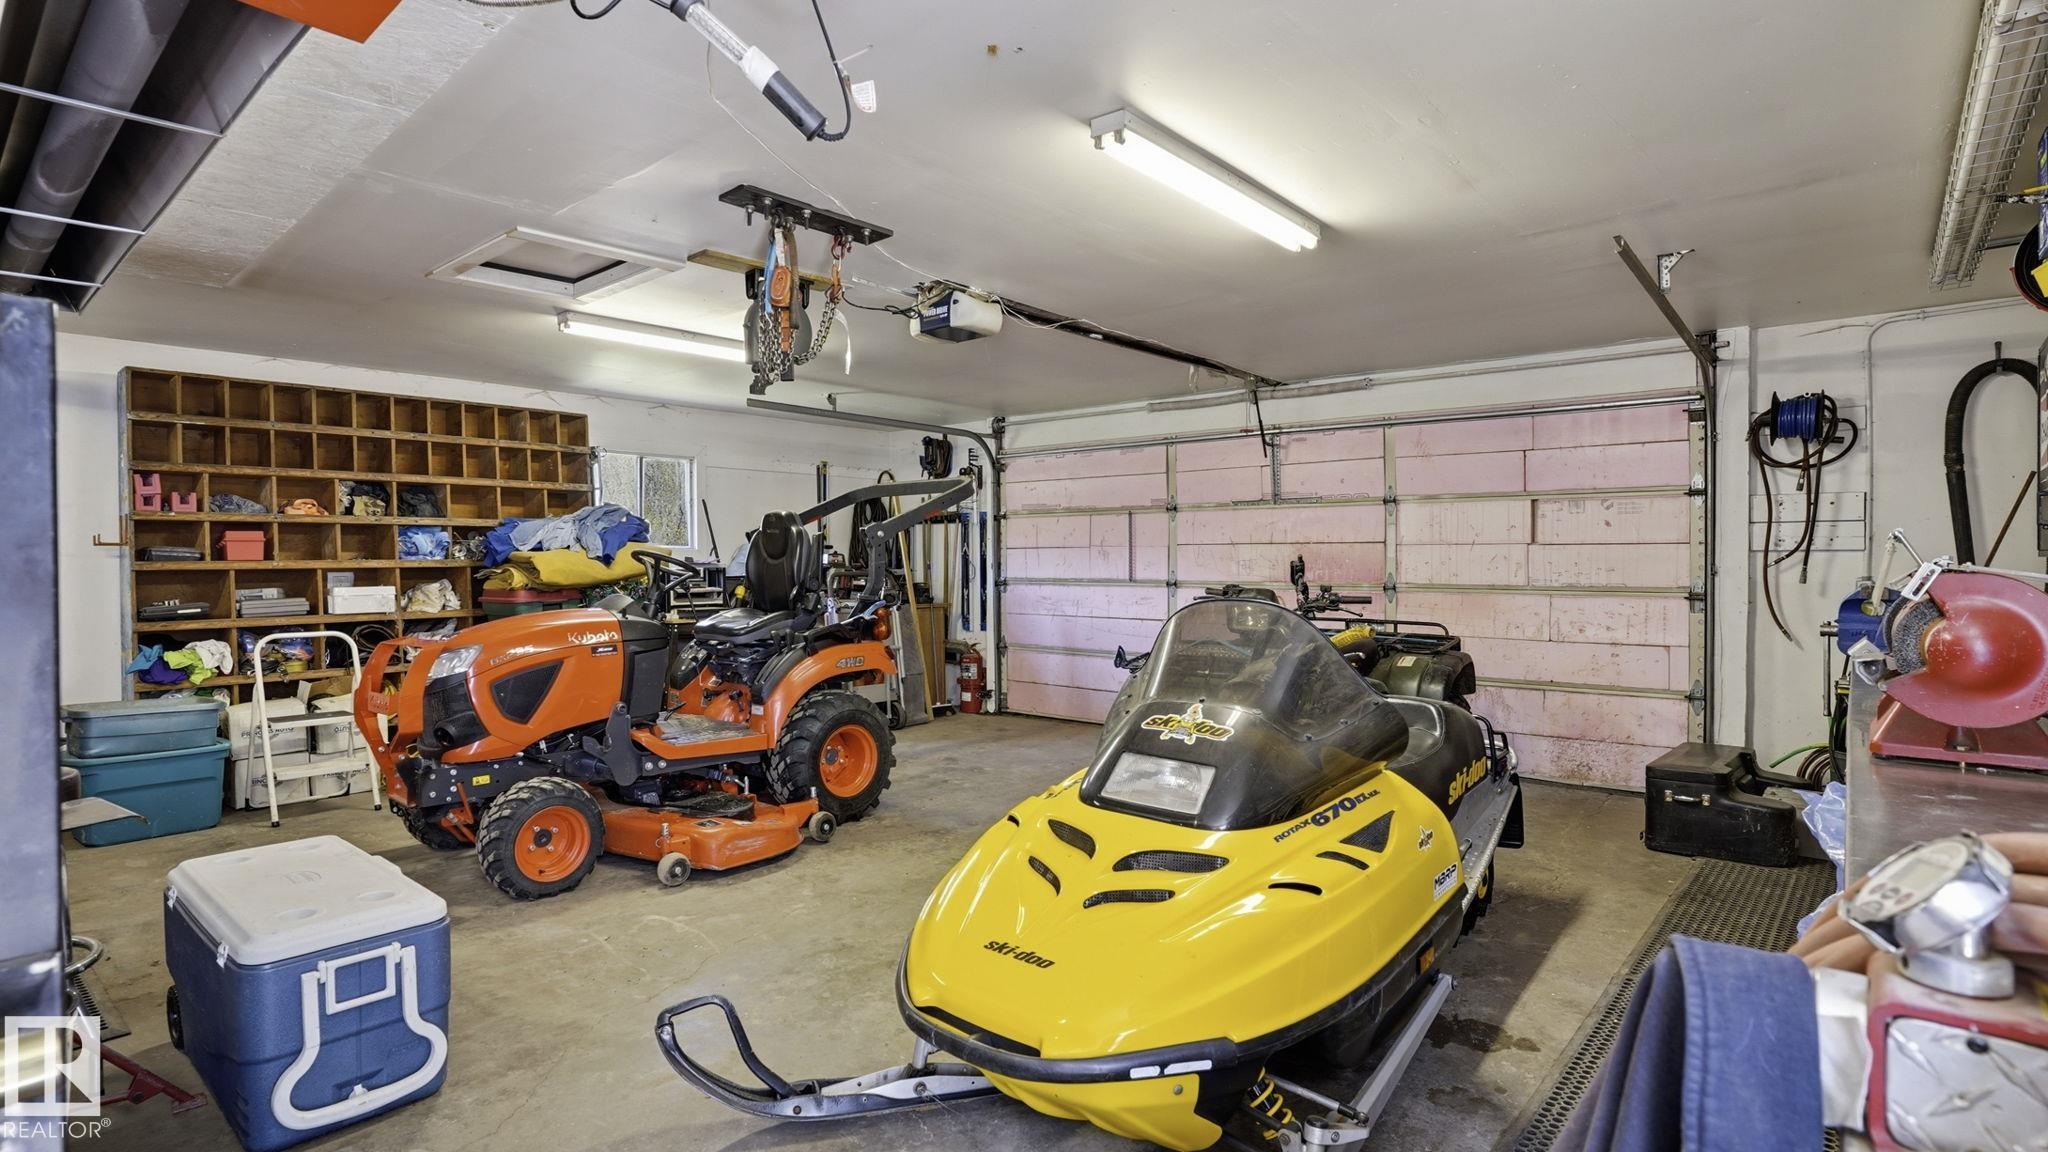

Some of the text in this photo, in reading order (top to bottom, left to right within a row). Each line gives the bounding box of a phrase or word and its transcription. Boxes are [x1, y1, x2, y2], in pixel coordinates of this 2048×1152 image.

[567, 629, 618, 645] Kubota
[836, 656, 864, 668] 4WD
[1448, 756, 1487, 805] ski-doo
[1273, 817, 1312, 843] ROTAX
[1311, 797, 1357, 827] 670
[983, 940, 1056, 969] ski-doo
